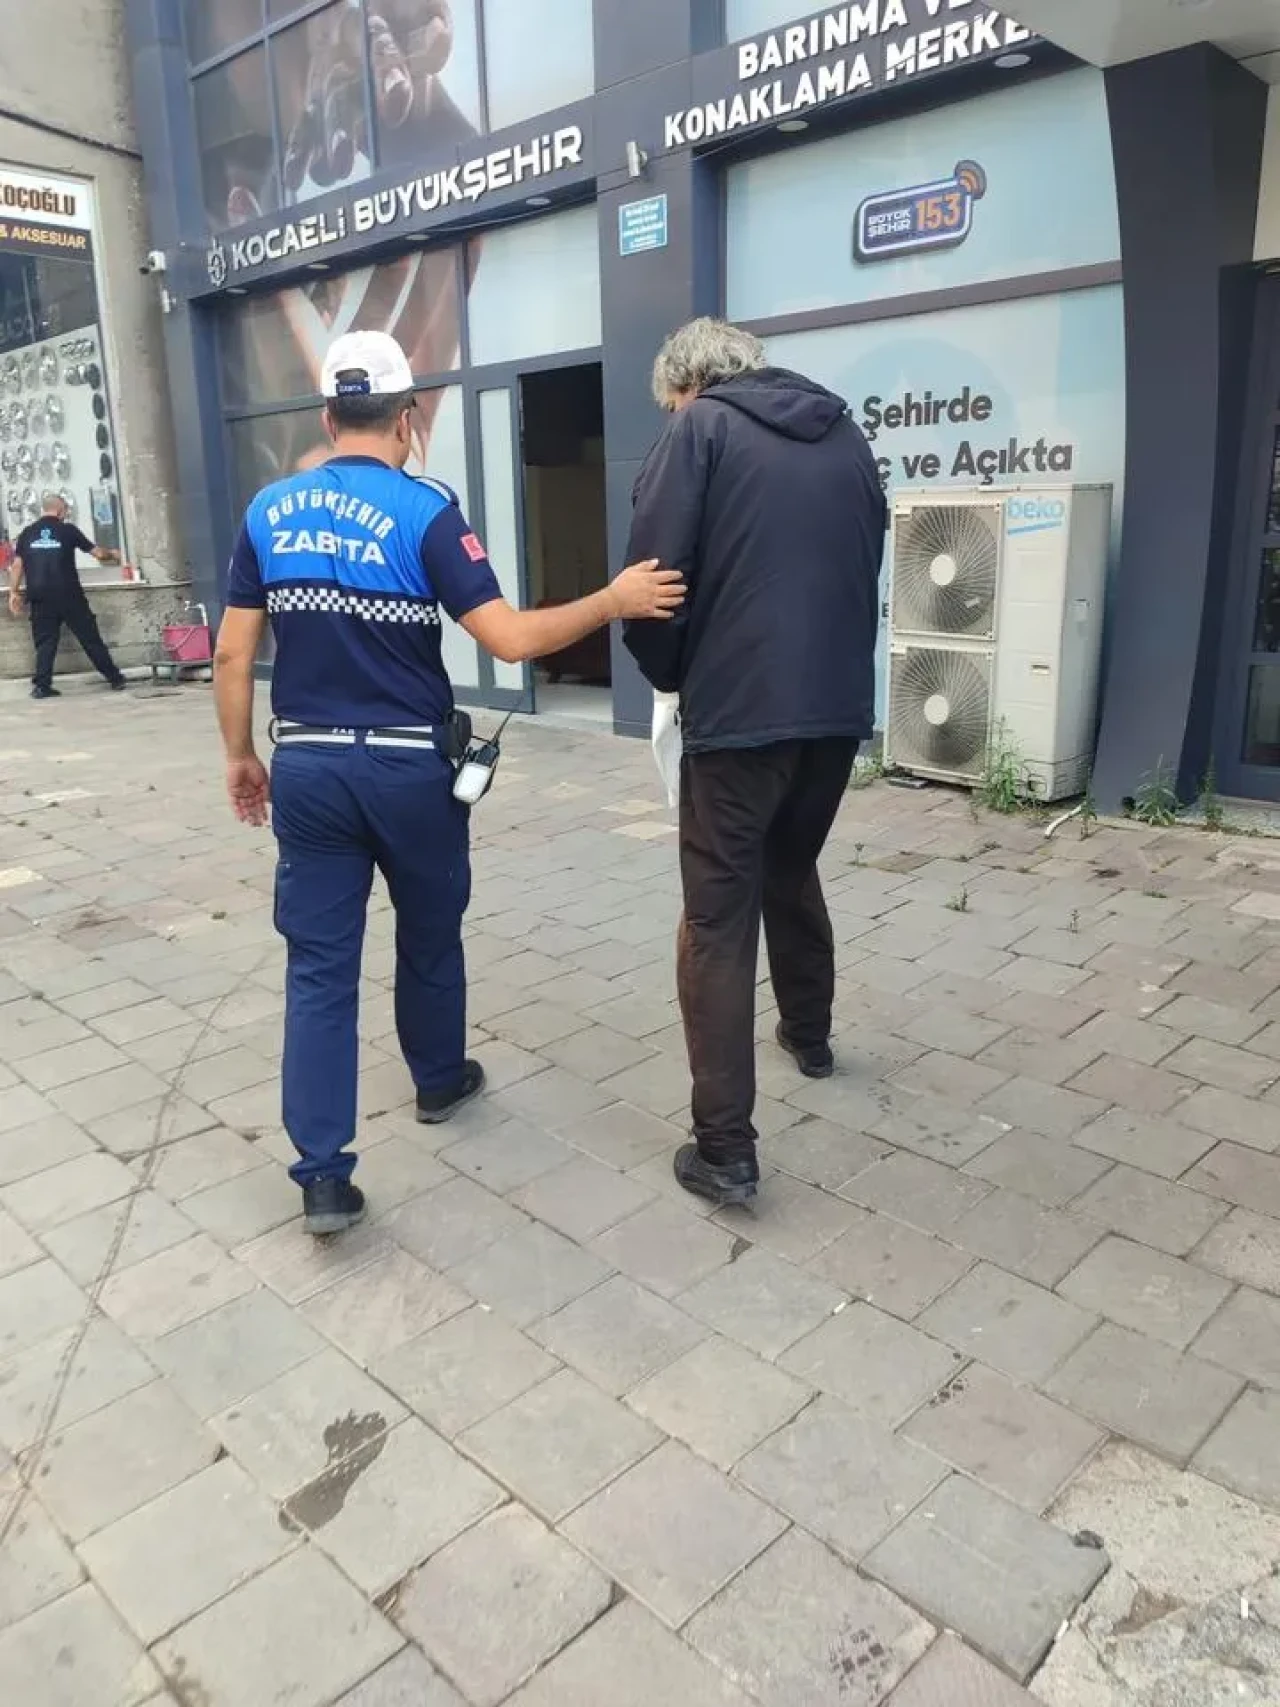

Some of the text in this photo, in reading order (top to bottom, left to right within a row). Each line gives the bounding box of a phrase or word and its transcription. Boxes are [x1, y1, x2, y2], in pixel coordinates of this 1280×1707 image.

[738, 0, 908, 81] BARINMA
[664, 53, 873, 148] KONAKLAMA
[0, 184, 77, 217] OÇOĞLU
[915, 192, 961, 232] 153
[11, 226, 87, 251] AKSESUAR
[862, 385, 993, 442] Şehirde
[902, 452, 941, 480] ve
[950, 437, 1073, 486] Açıkta
[1007, 496, 1066, 520] beko
